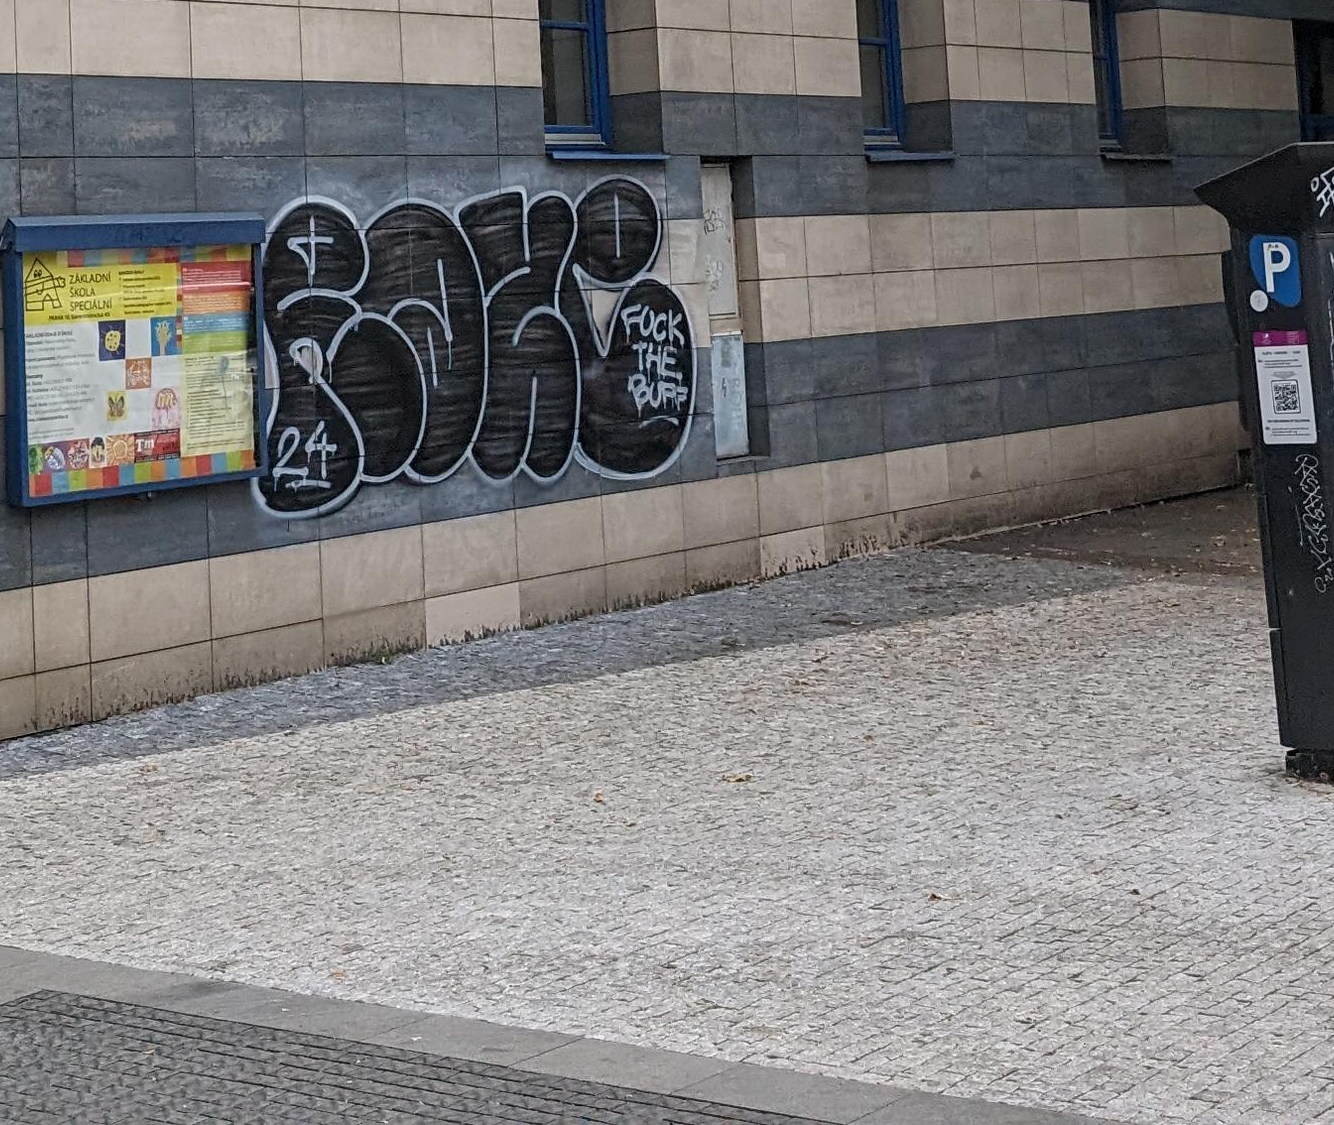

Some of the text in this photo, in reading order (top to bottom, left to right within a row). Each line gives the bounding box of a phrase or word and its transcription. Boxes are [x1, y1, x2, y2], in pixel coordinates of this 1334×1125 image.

[69, 271, 112, 285] ZÁKLADNÍ
[1262, 241, 1292, 293] P
[69, 286, 96, 298] ŠKOLA
[69, 298, 113, 312] SPECIÁLNÍ
[620, 303, 685, 347] FUCK
[631, 340, 683, 379] THE
[272, 420, 337, 481] 24
